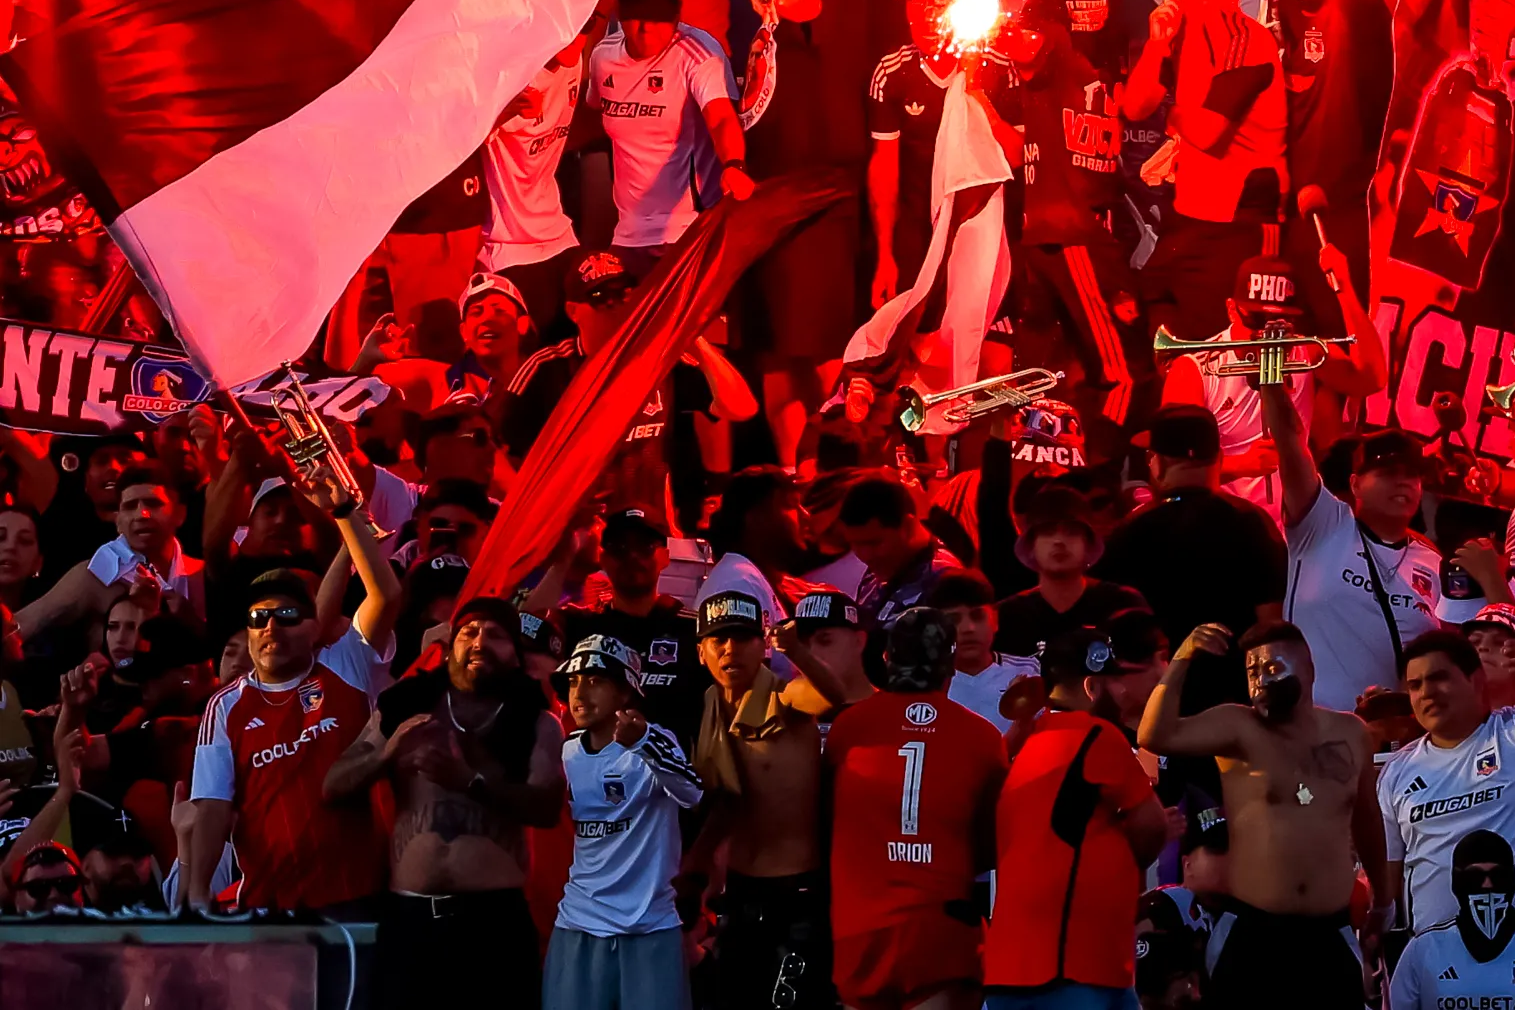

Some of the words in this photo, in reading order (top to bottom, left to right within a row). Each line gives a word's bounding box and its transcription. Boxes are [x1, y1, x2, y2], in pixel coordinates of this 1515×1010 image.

[2, 326, 133, 426] NTE
[126, 396, 192, 410] COLO-CO
[1013, 443, 1085, 466] ANCA
[1341, 568, 1412, 607] COOET
[908, 703, 935, 723] MG
[252, 724, 319, 768] COOLET
[898, 741, 925, 835] 1
[1424, 785, 1505, 818] JUGABET
[887, 841, 932, 863] ORION
